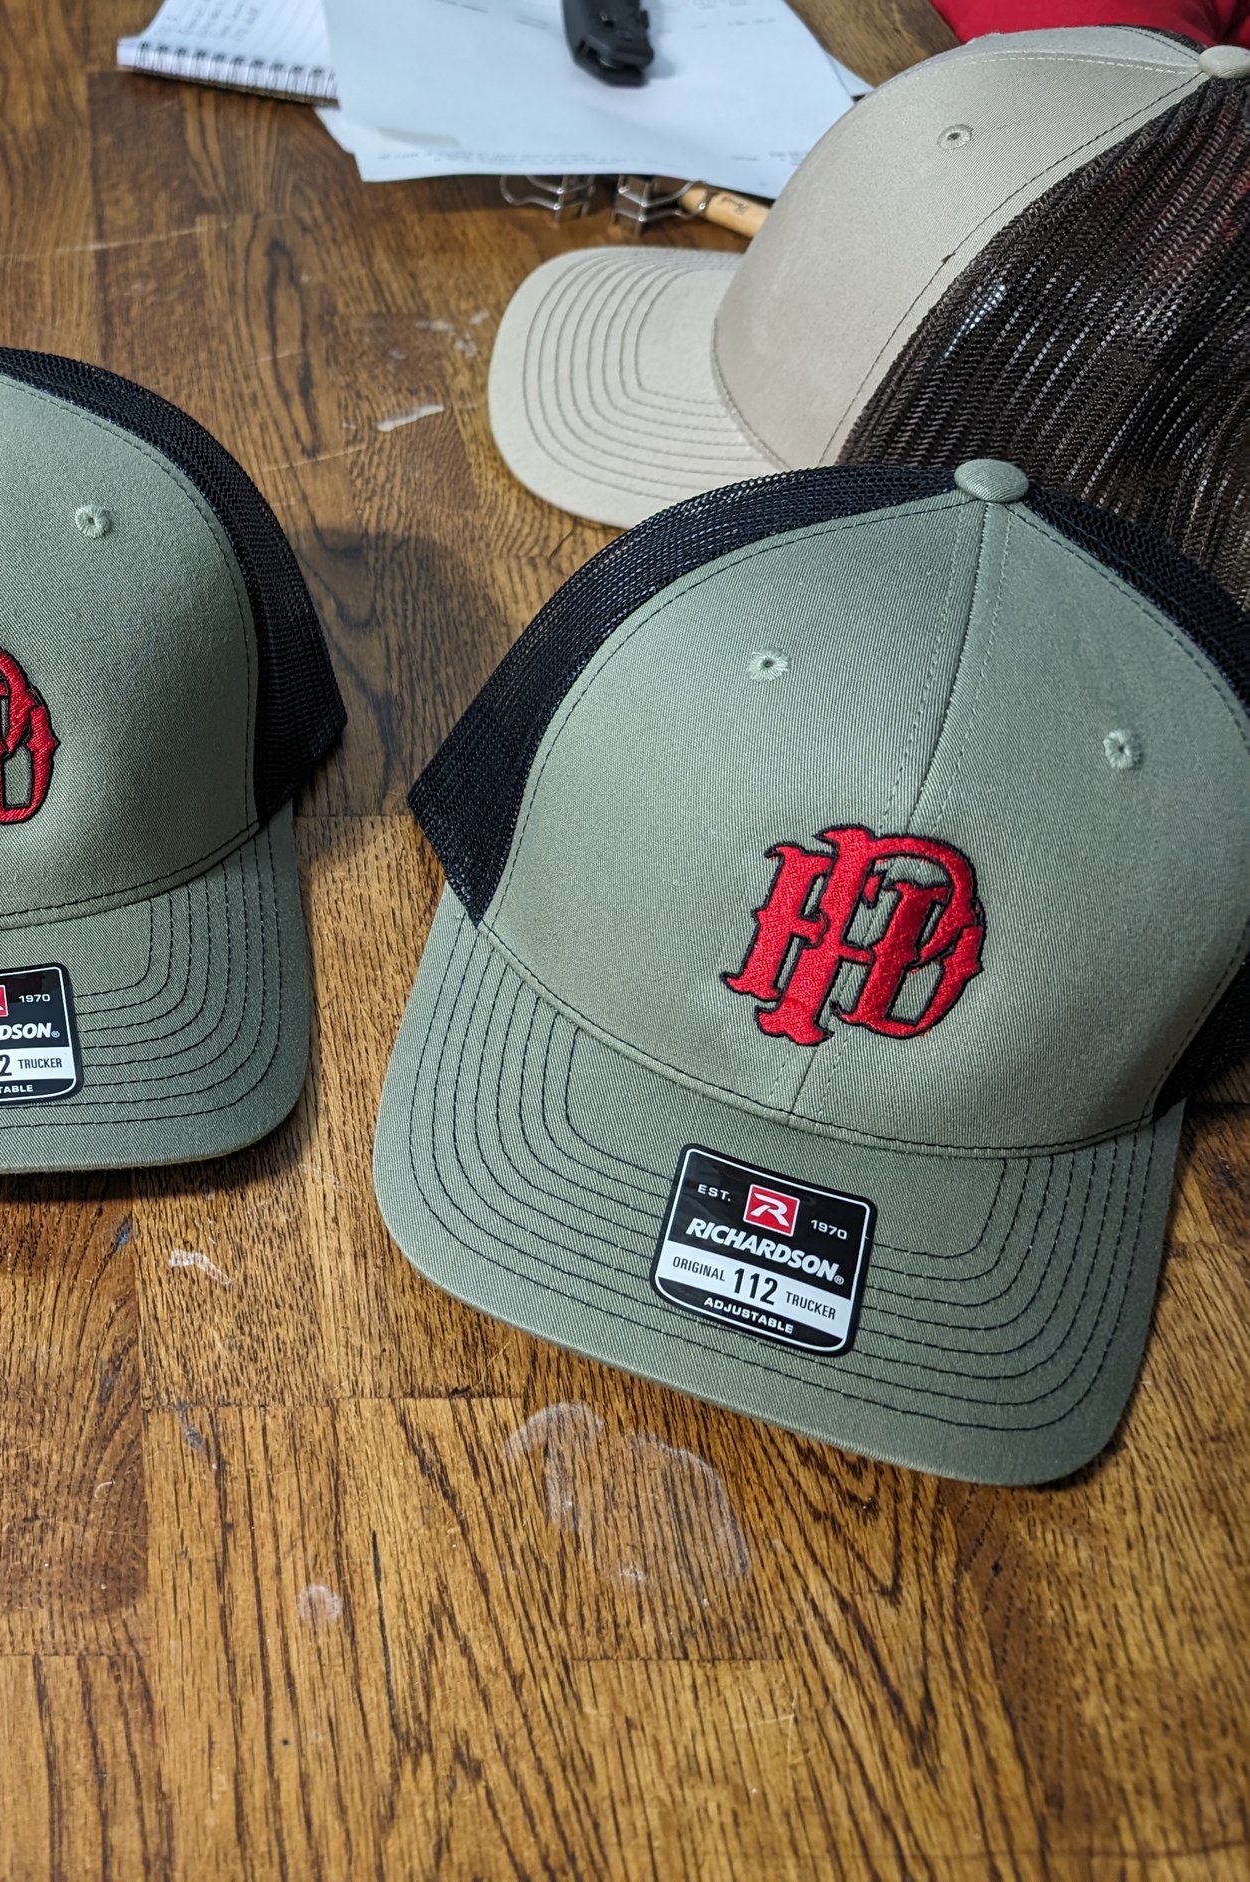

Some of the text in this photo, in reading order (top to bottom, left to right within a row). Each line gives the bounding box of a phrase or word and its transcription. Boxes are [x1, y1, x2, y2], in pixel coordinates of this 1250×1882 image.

[18, 993, 50, 1003] 1970
[18, 1058, 63, 1069] TRUCKER
[697, 1184, 848, 1240] EST. 1970
[672, 1256, 836, 1320] ORIGINAL 112 TRUCKER
[703, 1297, 794, 1334] ADJUSTABLE
